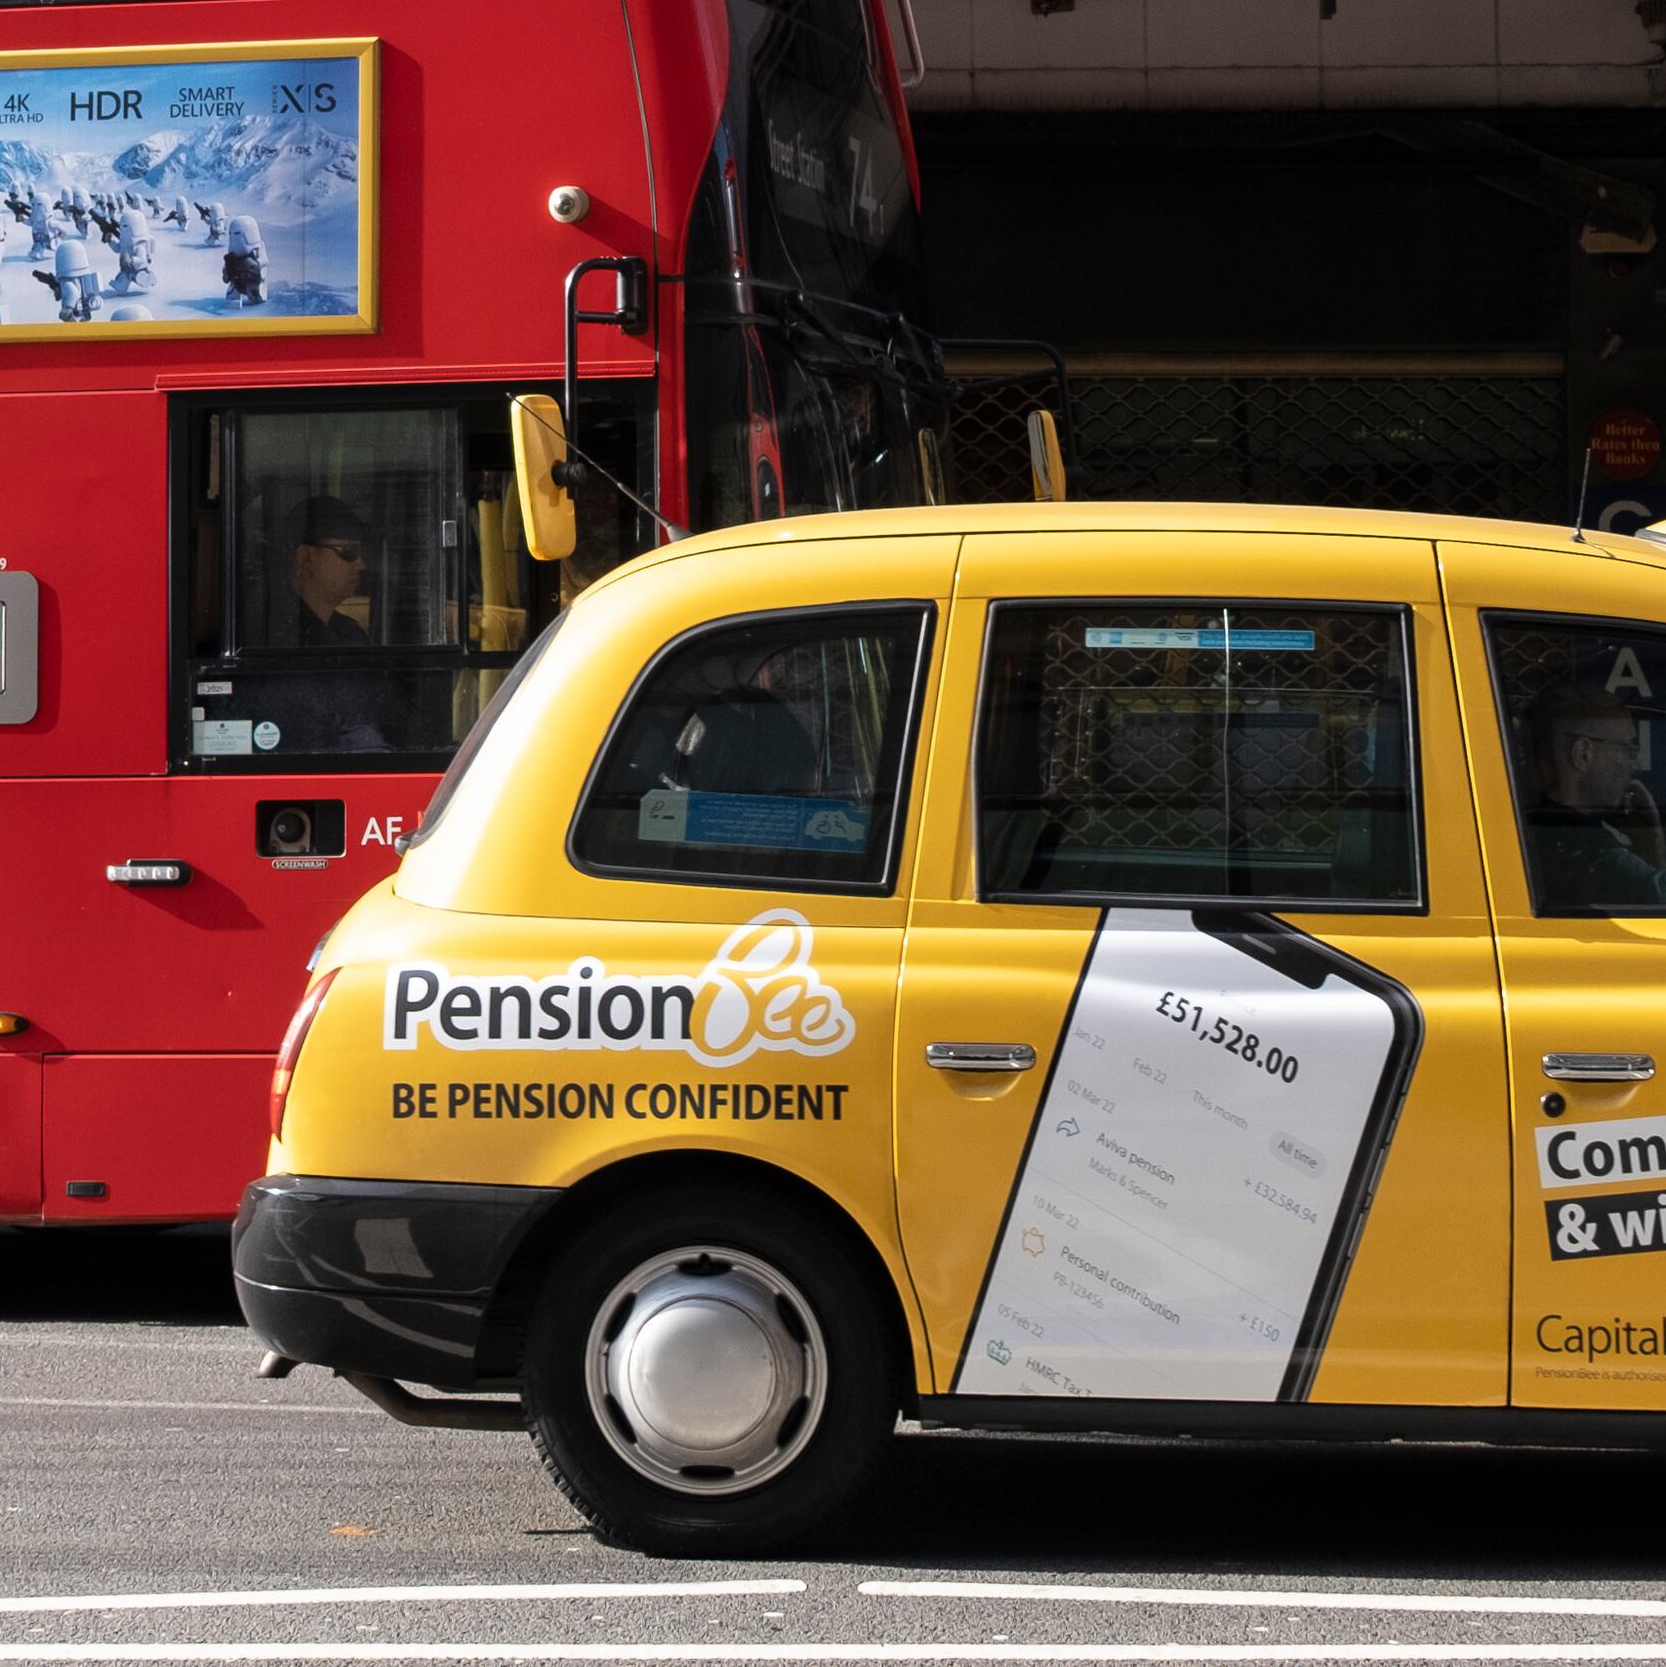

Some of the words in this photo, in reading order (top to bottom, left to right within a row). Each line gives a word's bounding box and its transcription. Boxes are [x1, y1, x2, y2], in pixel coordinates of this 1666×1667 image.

[4, 94, 30, 112] 4K
[70, 90, 143, 121] HDR
[170, 101, 245, 119] DELIVERY
[179, 86, 235, 103] SMART
[27, 112, 44, 123] HD
[1591, 438, 1628, 451] Rates
[1631, 438, 1661, 451] then
[1606, 423, 1646, 436] Better
[1606, 452, 1646, 465] Banks
[360, 816, 403, 846] AF
[275, 859, 326, 869] SCREENWASH
[1156, 991, 1299, 1083] £51,528.00
[1133, 1057, 1153, 1077] Feb
[1153, 1070, 1169, 1085] 22
[392, 1083, 437, 1118] BE
[448, 1083, 614, 1119] PENSION
[625, 1083, 849, 1120] CONFIDENT
[1066, 1079, 1081, 1095] 02
[1081, 1088, 1101, 1107] Mar
[1101, 1099, 1117, 1115] 22
[1192, 1090, 1213, 1112] This
[1213, 1105, 1249, 1131] month
[1096, 1132, 1127, 1159] Aviva
[1128, 1148, 1177, 1185] pension
[1277, 1139, 1293, 1156] All
[1293, 1147, 1318, 1170] time
[1089, 1157, 1118, 1184] Marks
[1118, 1173, 1128, 1188] &
[1127, 1179, 1169, 1211] Spencer
[1032, 1195, 1046, 1210] 10
[1045, 1201, 1066, 1221] Mar
[1065, 1214, 1081, 1230] 22
[1556, 1202, 1600, 1254] &
[1053, 1270, 1104, 1310] PB-123456
[1061, 1245, 1110, 1284] Personal
[1110, 1275, 1181, 1326] contribution
[997, 1301, 1013, 1318] 05
[1011, 1309, 1031, 1331] Feb
[1030, 1322, 1045, 1338] 22
[1249, 1316, 1281, 1343] £150
[1025, 1356, 1062, 1386] HMRC
[1062, 1375, 1088, 1396] Tax
[1535, 1366, 1600, 1380] PensionBee
[1602, 1368, 1610, 1380] is
